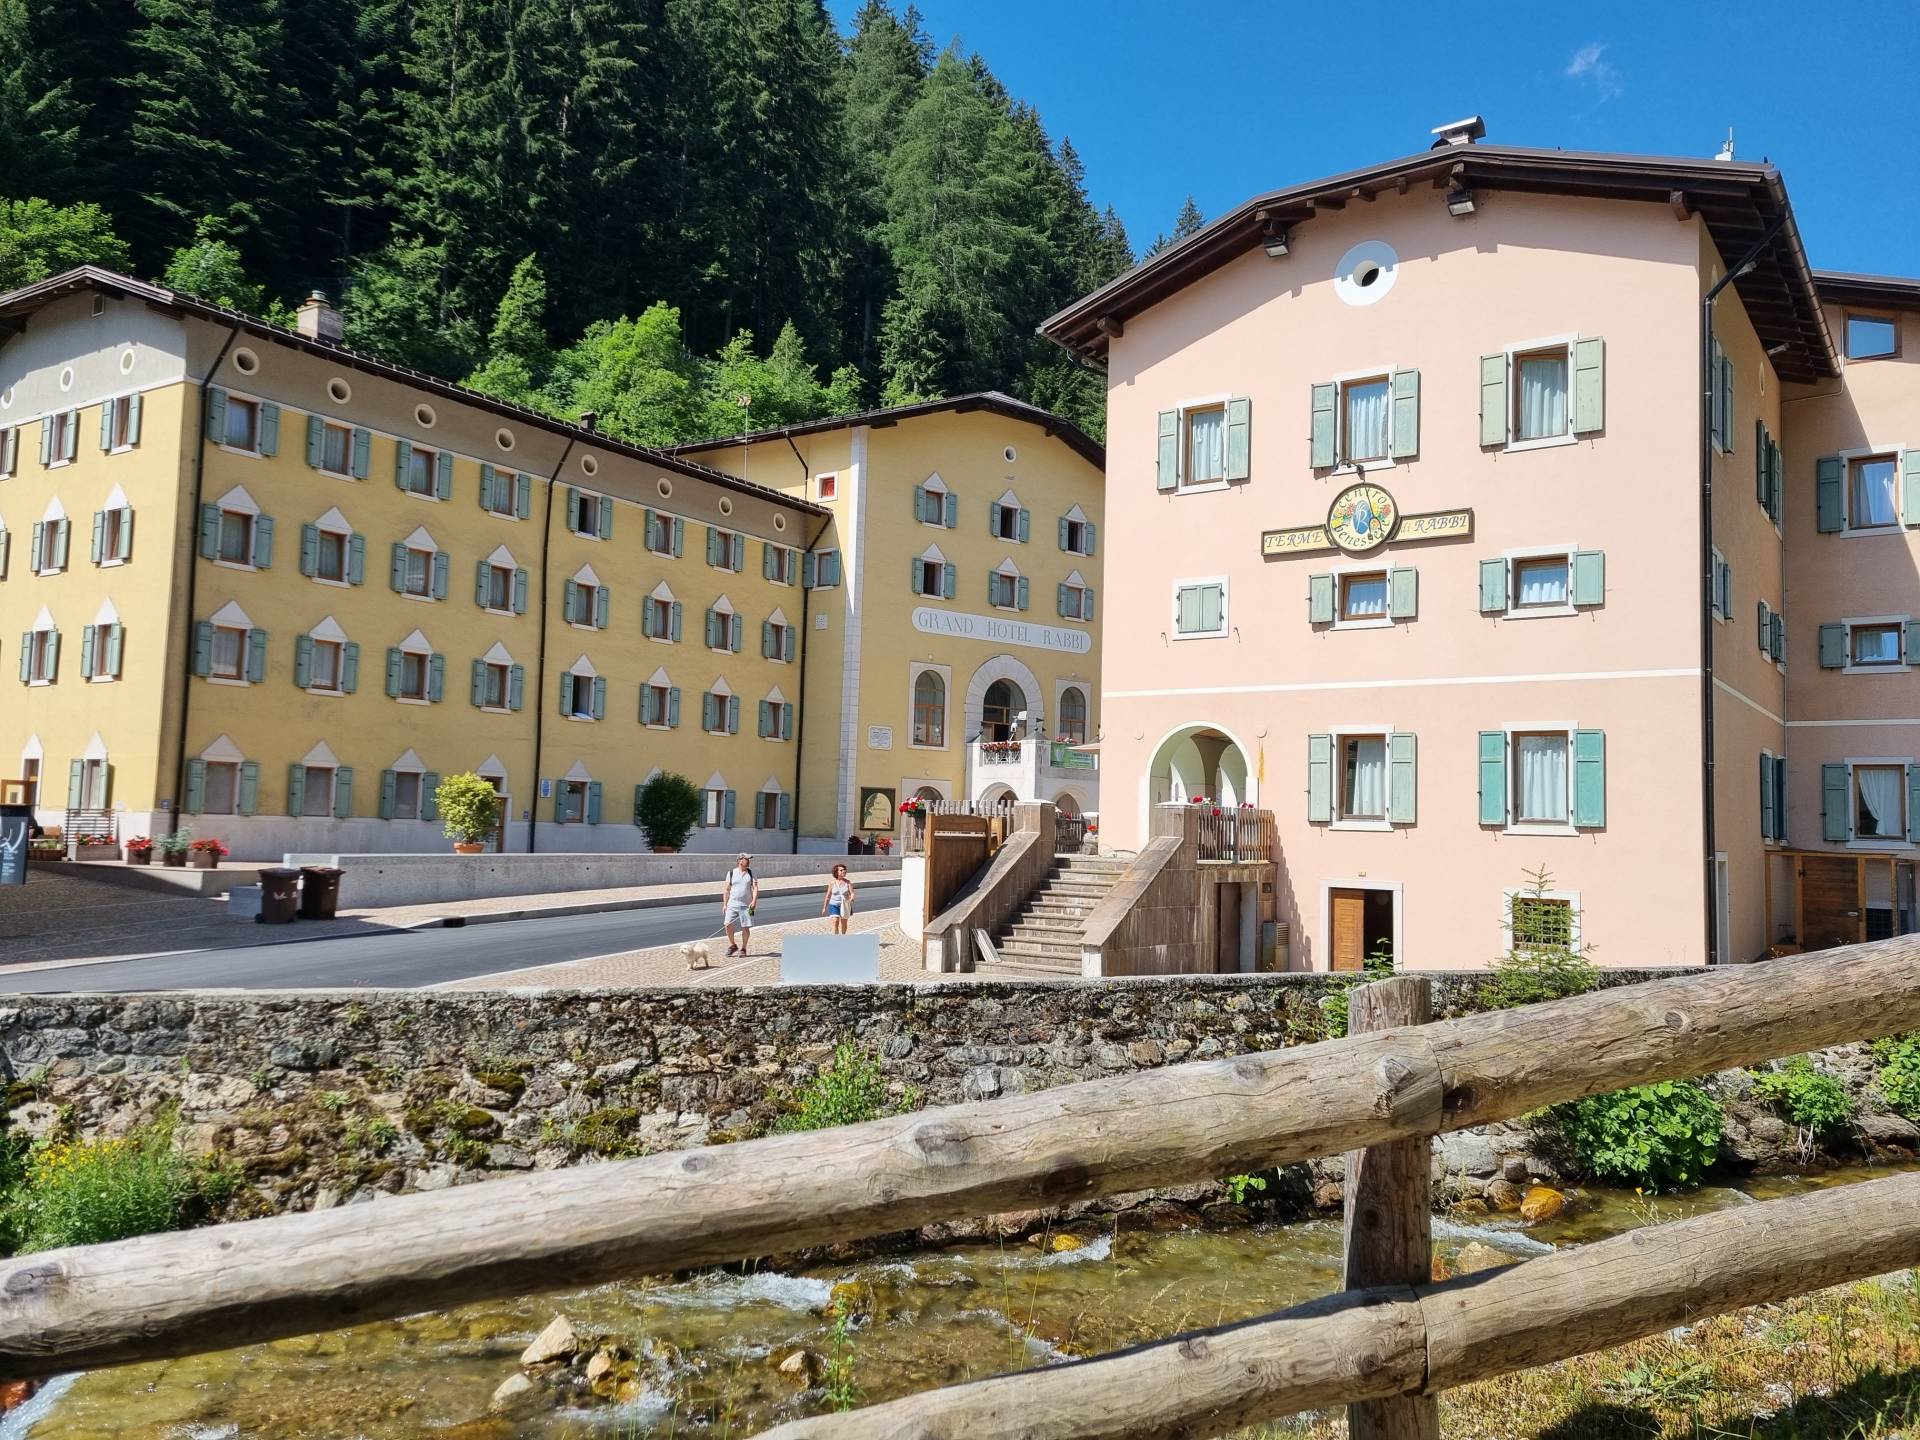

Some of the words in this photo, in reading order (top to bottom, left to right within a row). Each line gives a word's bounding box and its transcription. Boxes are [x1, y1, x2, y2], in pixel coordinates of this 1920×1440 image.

[1264, 530, 1323, 548] TERME
[1413, 515, 1467, 534] RABBI
[918, 611, 974, 634] GRAND
[986, 620, 1031, 643] HOTEL
[1043, 629, 1084, 650] RABBI
